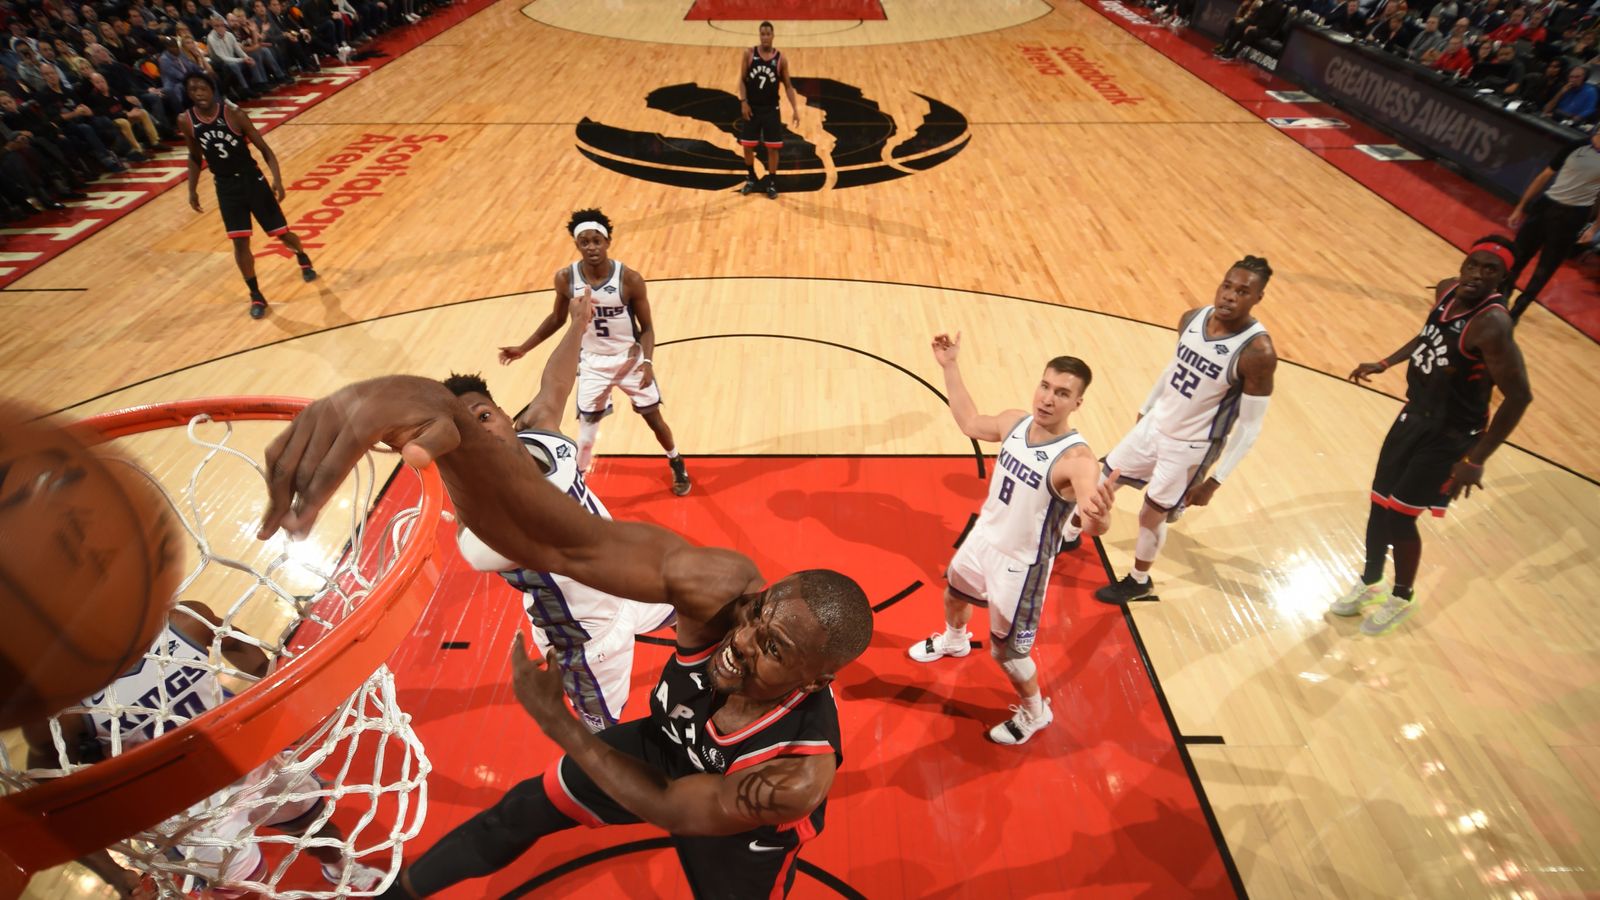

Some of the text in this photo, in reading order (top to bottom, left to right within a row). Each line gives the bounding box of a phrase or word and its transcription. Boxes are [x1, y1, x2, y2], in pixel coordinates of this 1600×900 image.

[1017, 44, 1065, 75] Arena
[1051, 46, 1145, 105] Scotiabank
[758, 75, 767, 89] 7
[1324, 57, 1420, 123] GREATNESS
[1410, 99, 1500, 162] AWAITS
[214, 142, 228, 158] 3
[286, 133, 398, 191] Arena
[253, 134, 449, 259] Scotiabank
[594, 319, 610, 338] 5
[1419, 324, 1450, 367] APTORS
[1177, 343, 1223, 381] KINGS
[1411, 343, 1436, 374] 43
[1169, 363, 1201, 399] 22
[997, 449, 1043, 491] KINGS
[998, 476, 1016, 506] 8
[101, 655, 208, 734] KINGS
